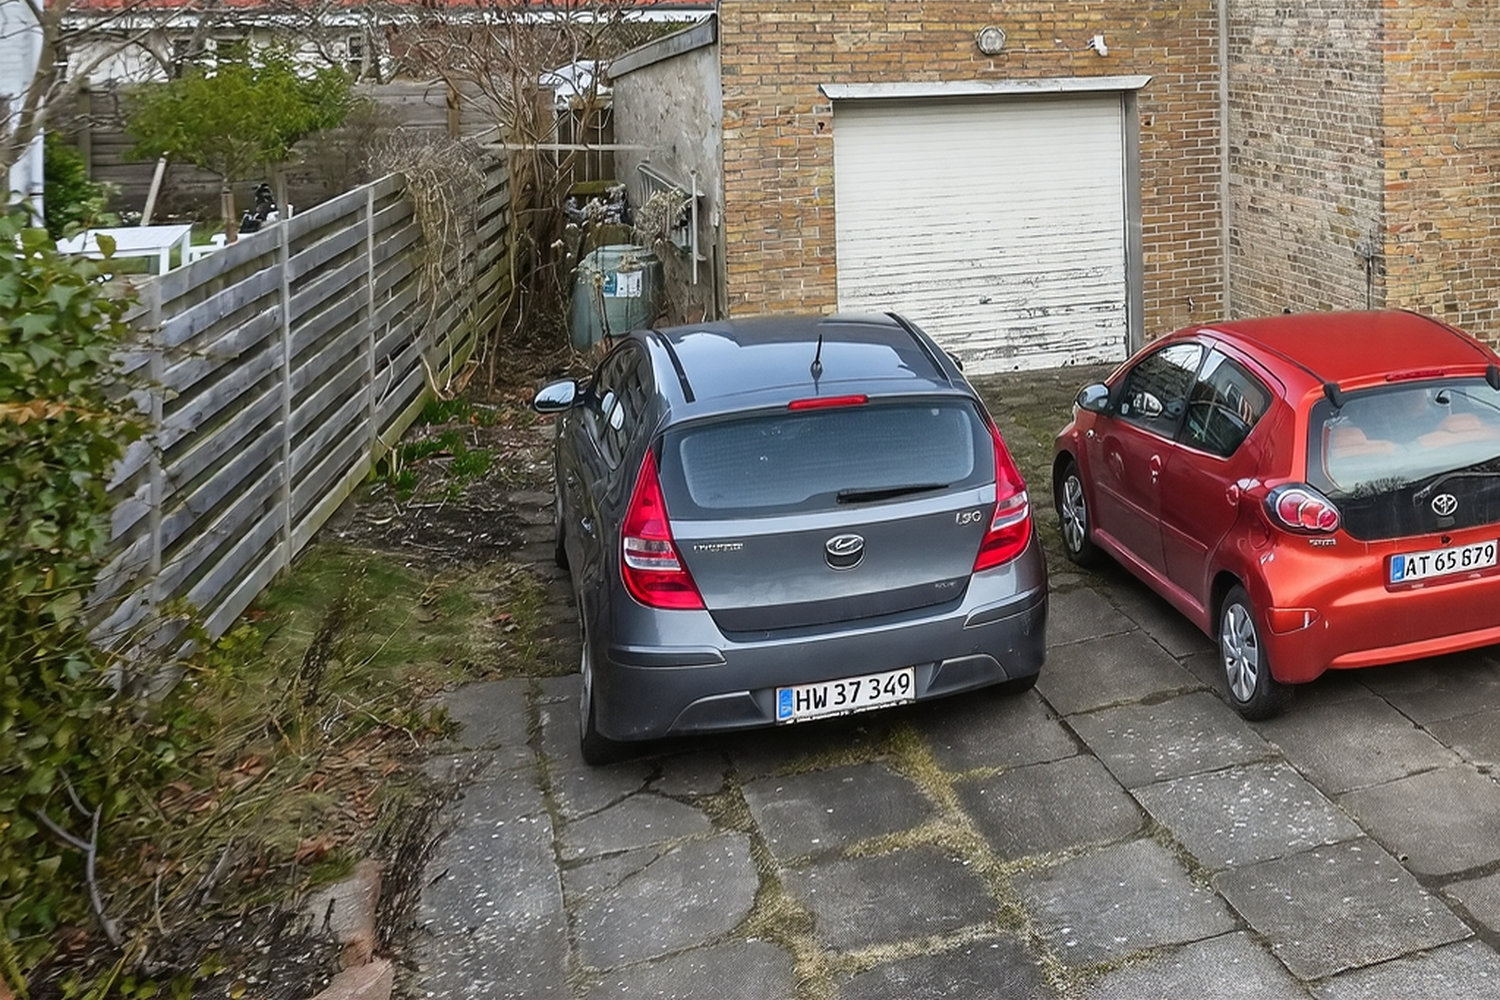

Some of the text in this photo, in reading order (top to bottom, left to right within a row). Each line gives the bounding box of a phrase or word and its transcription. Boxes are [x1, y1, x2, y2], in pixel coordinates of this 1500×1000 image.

[1406, 544, 1494, 576] AT 65 879
[796, 673, 910, 711] HW 37 349
